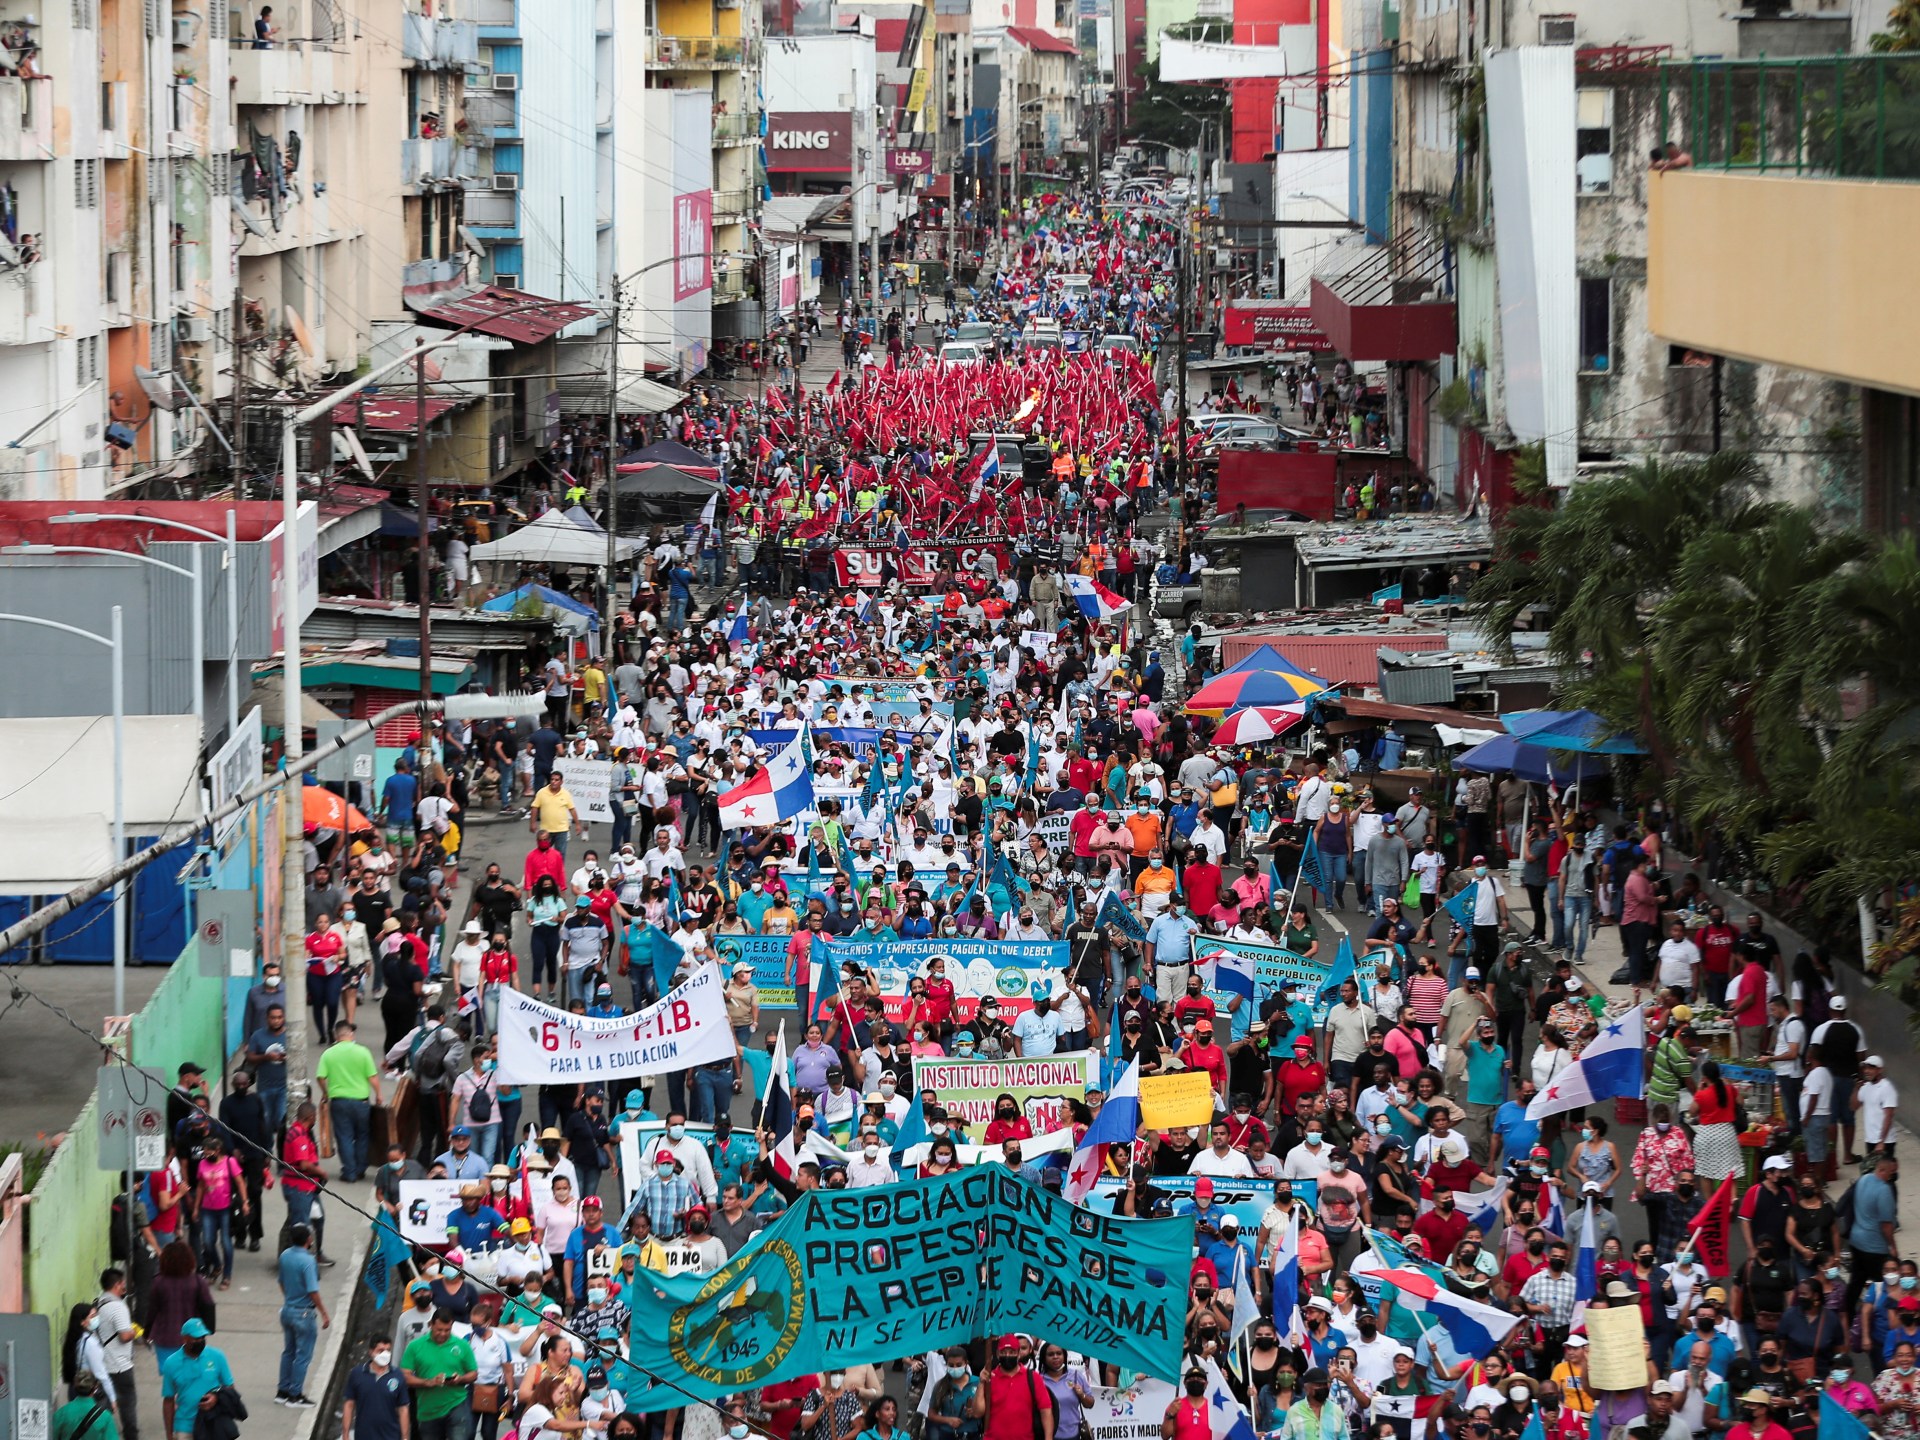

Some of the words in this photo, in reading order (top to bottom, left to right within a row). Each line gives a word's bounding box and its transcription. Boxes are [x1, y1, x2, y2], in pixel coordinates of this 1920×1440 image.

[773, 131, 830, 149] KING
[687, 891, 713, 910] NY
[876, 943, 883, 954] Y
[886, 943, 949, 955] EMPRESARIOS
[951, 943, 985, 956] PAGUEN
[988, 945, 998, 956] LO
[1001, 944, 1019, 956] QUE
[1022, 945, 1053, 957] DEBEN
[1237, 950, 1298, 966] ASOCIACIÓN
[1301, 959, 1314, 968] DE
[1265, 968, 1323, 983] REPÚBLICA
[551, 1054, 583, 1072] PARA
[588, 1054, 602, 1070] LA
[610, 1041, 678, 1067] EDUCACIÓN
[920, 1064, 1000, 1090] INSTITUTO
[1004, 1062, 1083, 1086] NACIONAL
[946, 1101, 996, 1123] PANA
[1256, 1182, 1266, 1190] de
[805, 1171, 1053, 1231] ASOCIACIÓN
[1070, 1207, 1127, 1248] DE
[592, 1254, 611, 1268] EL
[806, 1213, 1068, 1279] PROFESORES
[1079, 1248, 1136, 1290] DE
[810, 1285, 869, 1323] LA
[878, 1265, 974, 1314] REP.
[1020, 1261, 1169, 1341] PANAMÁ
[826, 1325, 858, 1351] NI
[873, 1317, 904, 1344] SE
[1006, 1299, 1034, 1321] SE
[1047, 1312, 1127, 1350] RINDE
[721, 1337, 760, 1363] 1945
[736, 1366, 756, 1385] DE
[1097, 1425, 1129, 1440] PADRES
[1130, 1425, 1136, 1438] Y
[1137, 1424, 1161, 1437] MADR
